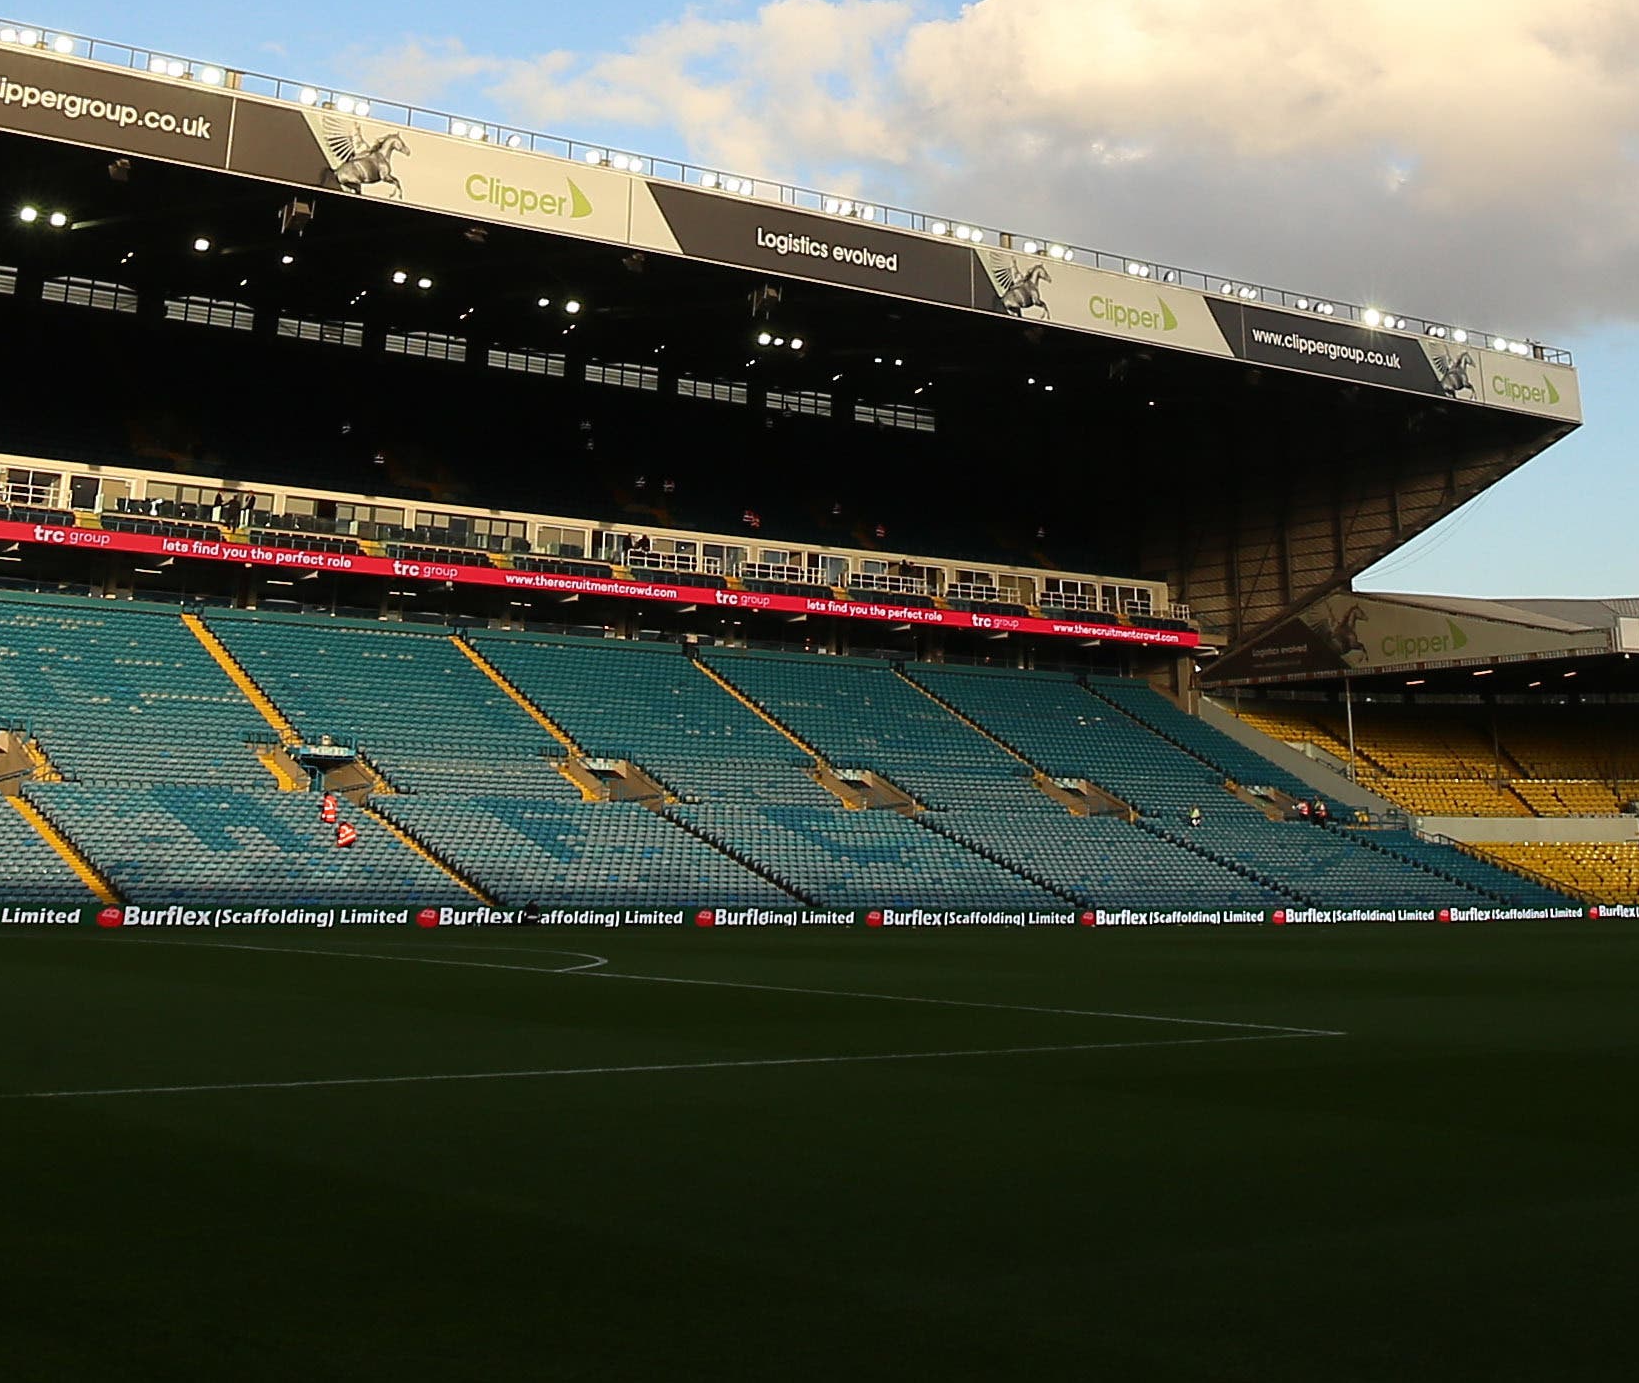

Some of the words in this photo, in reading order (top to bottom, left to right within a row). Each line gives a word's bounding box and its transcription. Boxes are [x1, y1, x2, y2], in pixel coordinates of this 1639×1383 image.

[465, 173, 567, 218] Clipper
[756, 227, 830, 261] Logistics
[832, 240, 898, 272] evolved
[1088, 295, 1160, 332] Clipper
[1251, 327, 1402, 370] www.clippergroup.co.uk
[1491, 374, 1547, 405] Clipper
[33, 525, 65, 544] trc
[69, 530, 111, 546] group
[162, 539, 189, 554] lets
[192, 540, 220, 556] find
[222, 546, 248, 561] you
[250, 546, 273, 561] the
[275, 549, 324, 566] perfect
[327, 555, 352, 568] role
[392, 561, 420, 577] trc
[422, 565, 458, 579] group
[505, 573, 678, 599] www.therecruitmentcrowd.com
[715, 589, 738, 606] trc
[740, 594, 770, 608] group
[828, 600, 848, 614] find
[887, 606, 923, 621] perfect
[971, 613, 992, 628] trc
[1382, 635, 1450, 658] Clipper
[1, 908, 81, 925] Limited
[123, 905, 212, 927] Burflex
[214, 908, 335, 928] (Scaffolding)
[340, 910, 409, 925] Limited
[438, 907, 513, 927] Burflex
[517, 910, 621, 928] (affolding)
[624, 911, 683, 925] Limited
[801, 911, 855, 925] Limited
[882, 909, 943, 927] Burflex
[944, 911, 1026, 927] (Scaffolding)
[1028, 911, 1075, 925] Limited
[1095, 909, 1148, 926] Burflex
[1223, 911, 1264, 923] Limited
[1285, 908, 1331, 924] Burflex
[1397, 909, 1435, 921] Limited
[1449, 907, 1491, 922] Burflex
